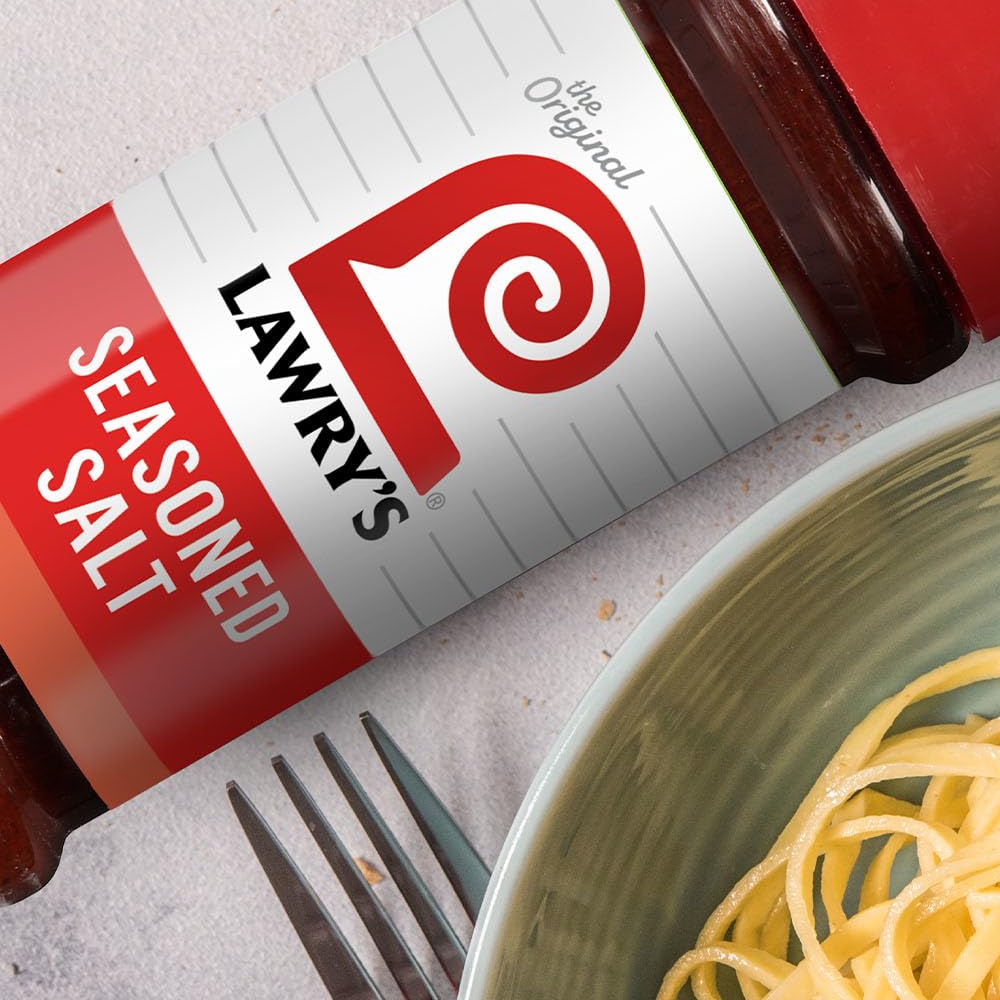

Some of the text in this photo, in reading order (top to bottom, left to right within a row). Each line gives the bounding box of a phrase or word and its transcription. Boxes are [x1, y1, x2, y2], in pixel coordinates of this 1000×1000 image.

[524, 77, 645, 190] Original
[566, 80, 602, 117] the
[69, 326, 290, 643] SEASONED
[218, 263, 408, 541] LAWRY'S
[38, 448, 177, 613] SALT
